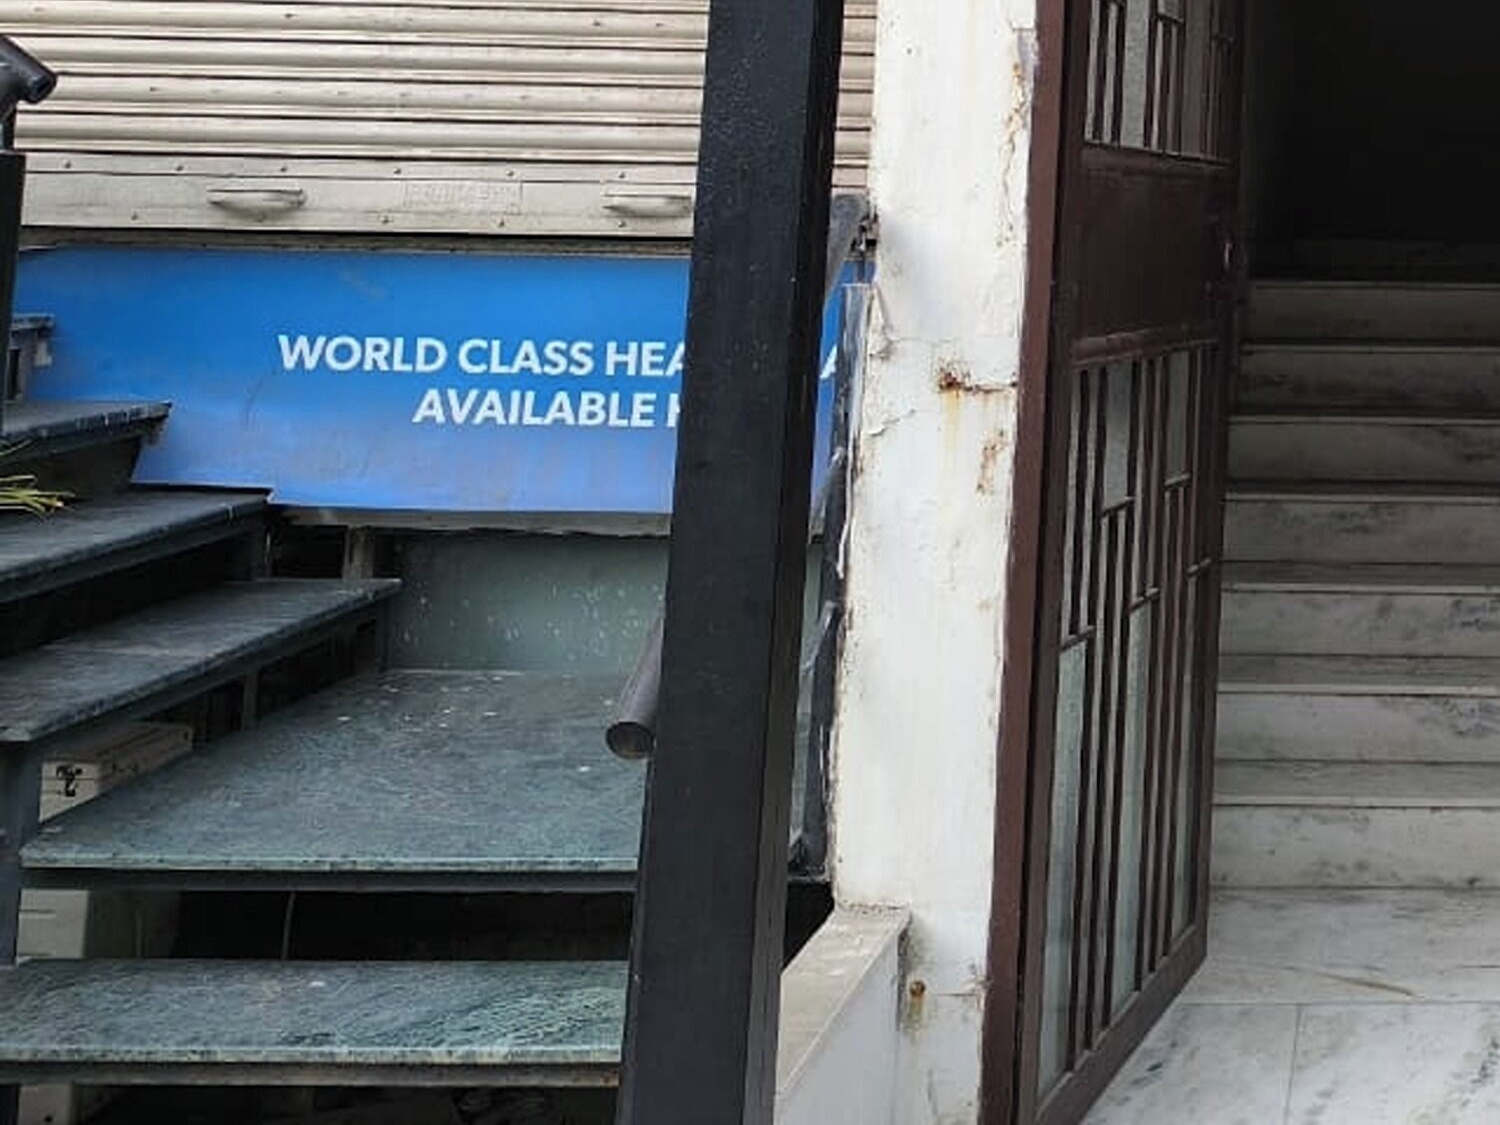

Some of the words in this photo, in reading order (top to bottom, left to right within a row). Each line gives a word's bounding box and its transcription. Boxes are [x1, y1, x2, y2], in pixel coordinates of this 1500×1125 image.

[277, 334, 447, 372] WORLD
[457, 339, 594, 375] CLASS
[412, 388, 656, 428] AVAILABLE
